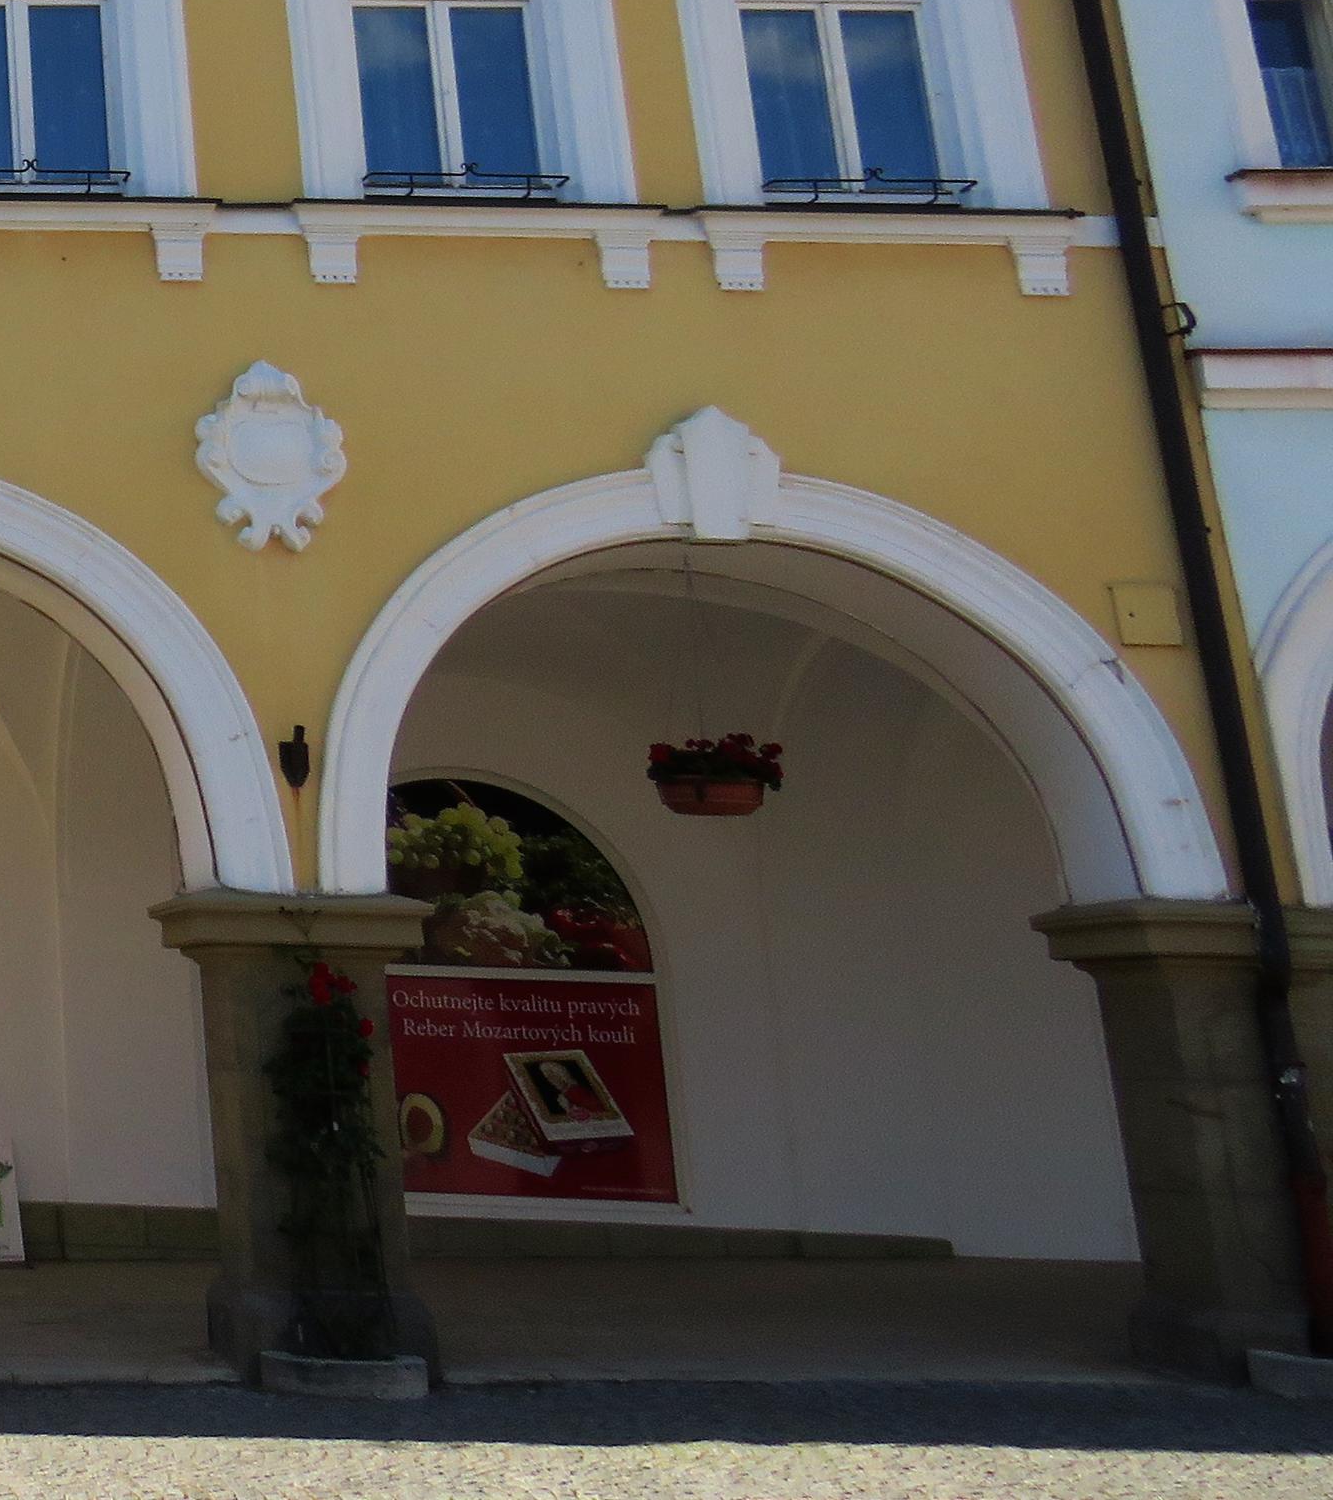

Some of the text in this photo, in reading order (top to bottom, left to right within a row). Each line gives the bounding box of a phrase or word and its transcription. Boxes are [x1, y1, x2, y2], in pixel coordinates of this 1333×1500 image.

[392, 989, 641, 1020] Ochutnejte kvalitu pravých
[402, 1018, 637, 1046] Reber Mozartových koulí
